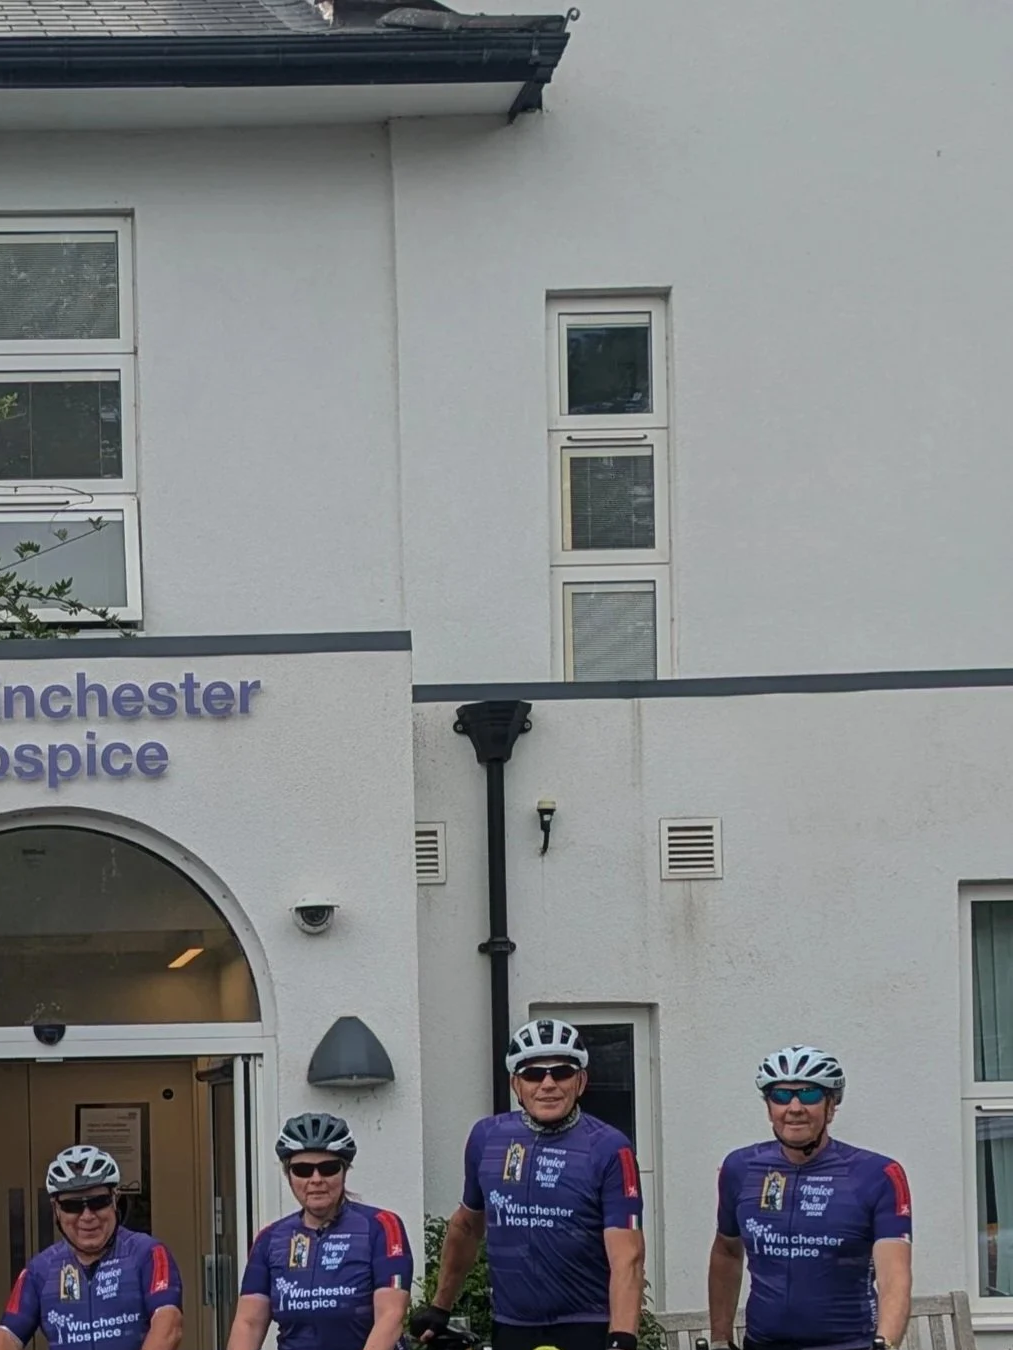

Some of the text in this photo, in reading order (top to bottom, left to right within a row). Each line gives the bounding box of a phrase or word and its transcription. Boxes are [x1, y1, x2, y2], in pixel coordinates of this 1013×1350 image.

[506, 1215, 554, 1228] Hospice
[763, 1245, 819, 1259] Hospice
[288, 1298, 337, 1310] Hospice
[67, 1328, 121, 1344] Hospice
